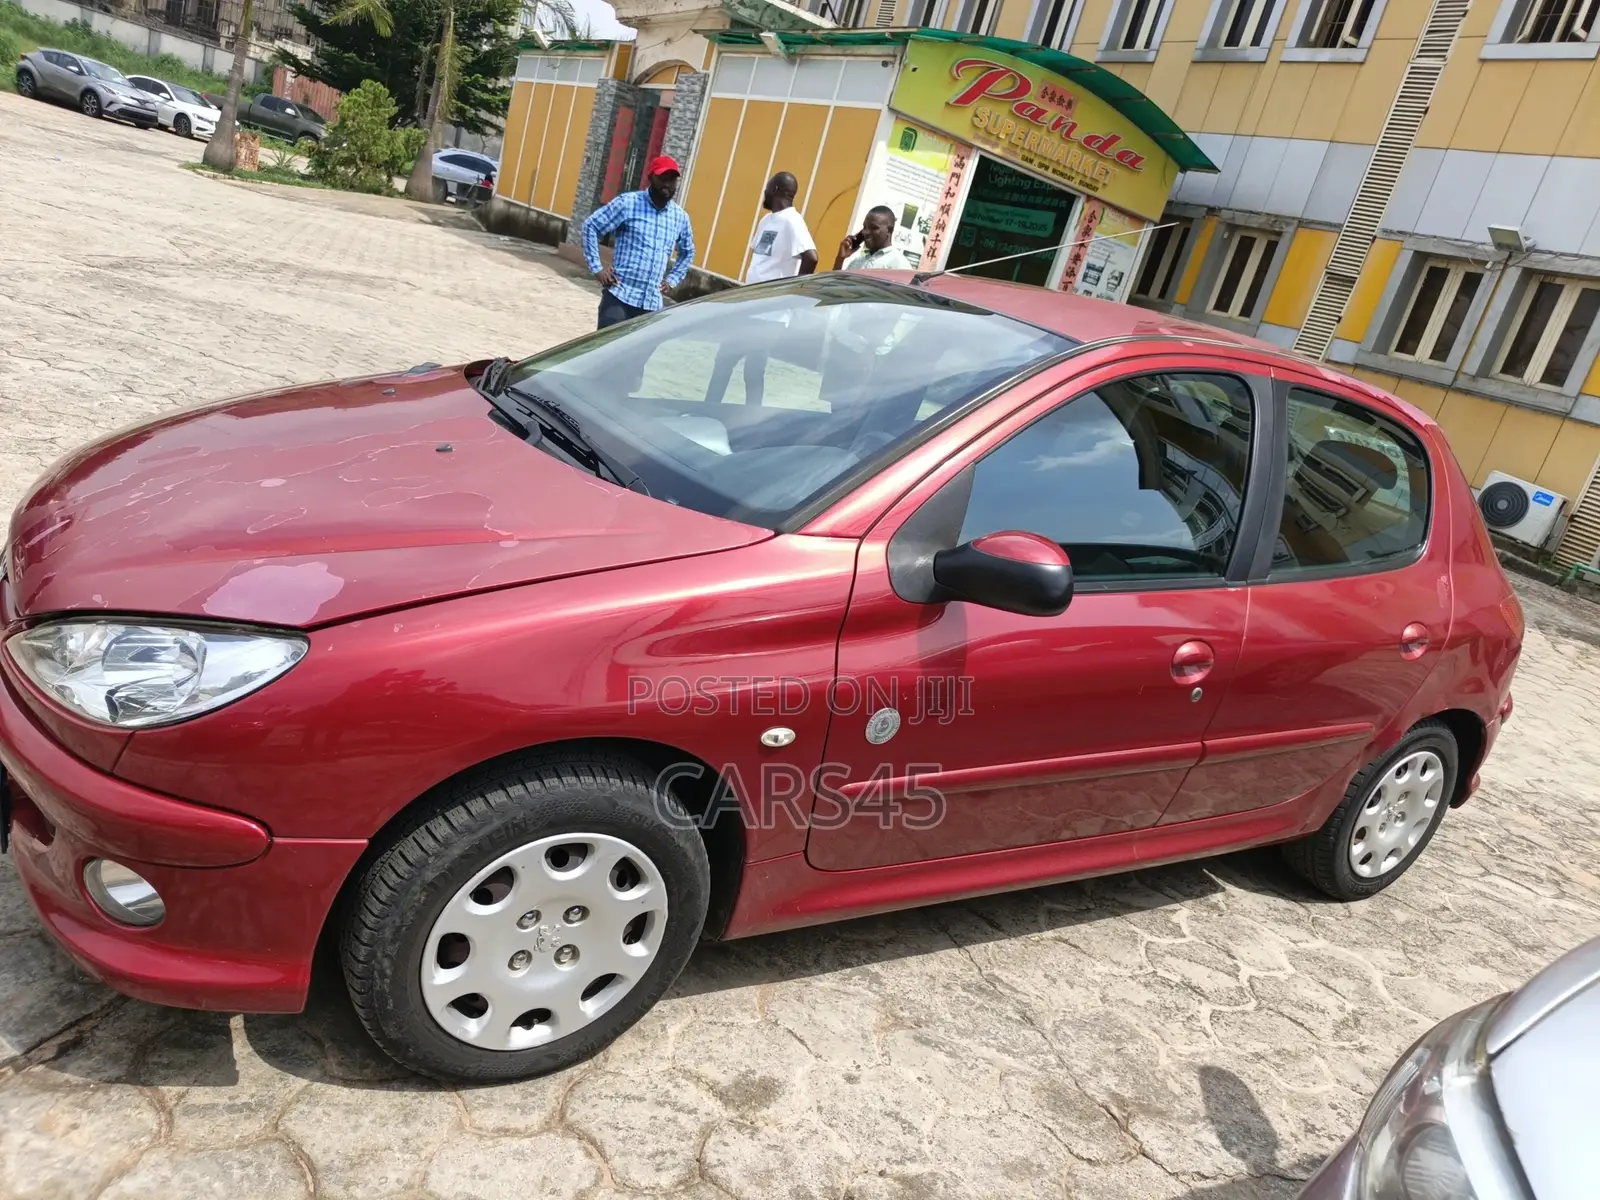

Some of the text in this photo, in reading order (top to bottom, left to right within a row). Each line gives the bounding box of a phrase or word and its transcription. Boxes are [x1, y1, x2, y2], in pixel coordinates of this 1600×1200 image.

[950, 57, 1147, 172] Panda
[972, 107, 1119, 186] SUPERMARKET
[988, 174, 1031, 190] Lighting
[1052, 166, 1075, 182] MONDAY
[1078, 177, 1100, 193] SUNDAY
